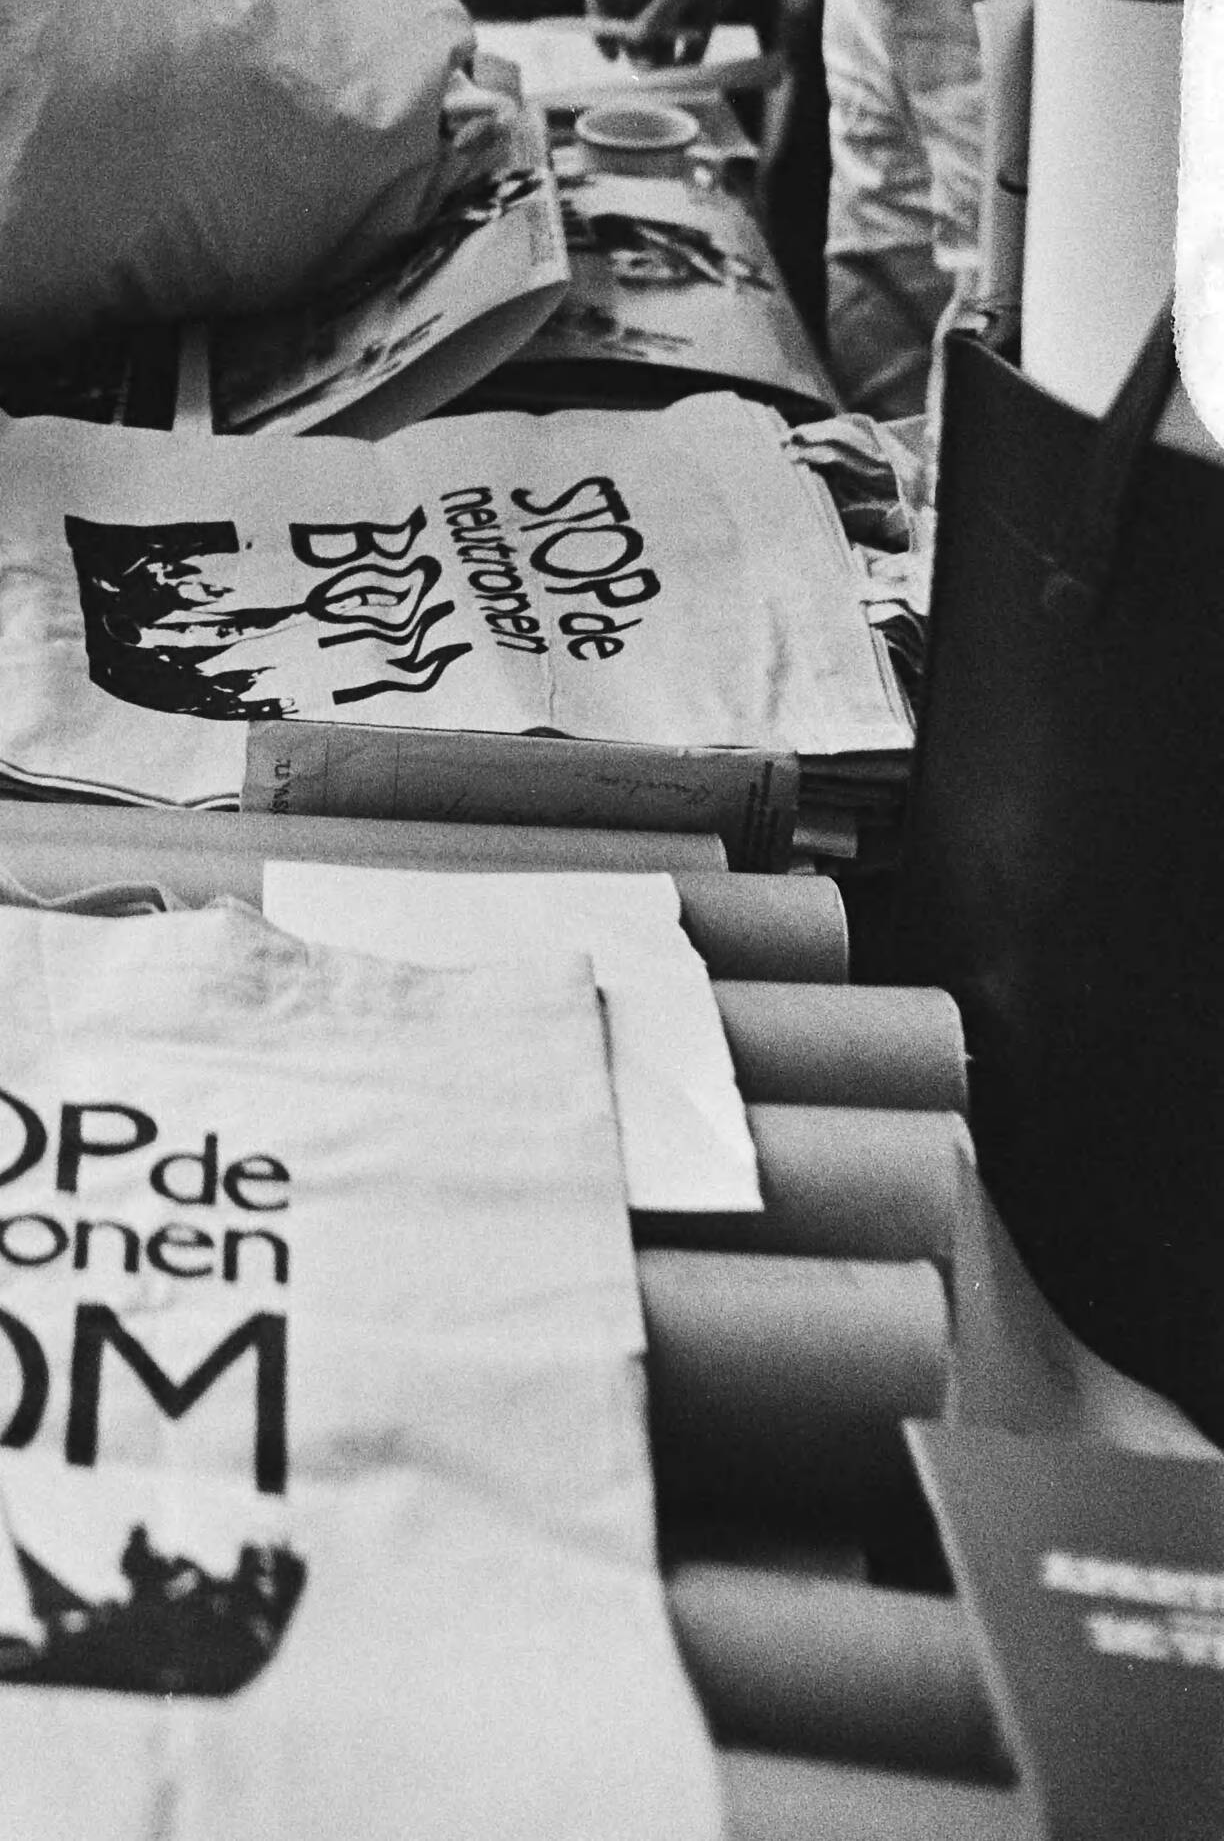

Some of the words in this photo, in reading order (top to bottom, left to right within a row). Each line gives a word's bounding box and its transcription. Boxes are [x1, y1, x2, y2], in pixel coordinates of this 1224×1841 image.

[288, 504, 474, 706] BOM
[440, 485, 552, 657] neutronen
[511, 475, 662, 609] STOP
[558, 612, 644, 662] de
[149, 1131, 292, 1211] de
